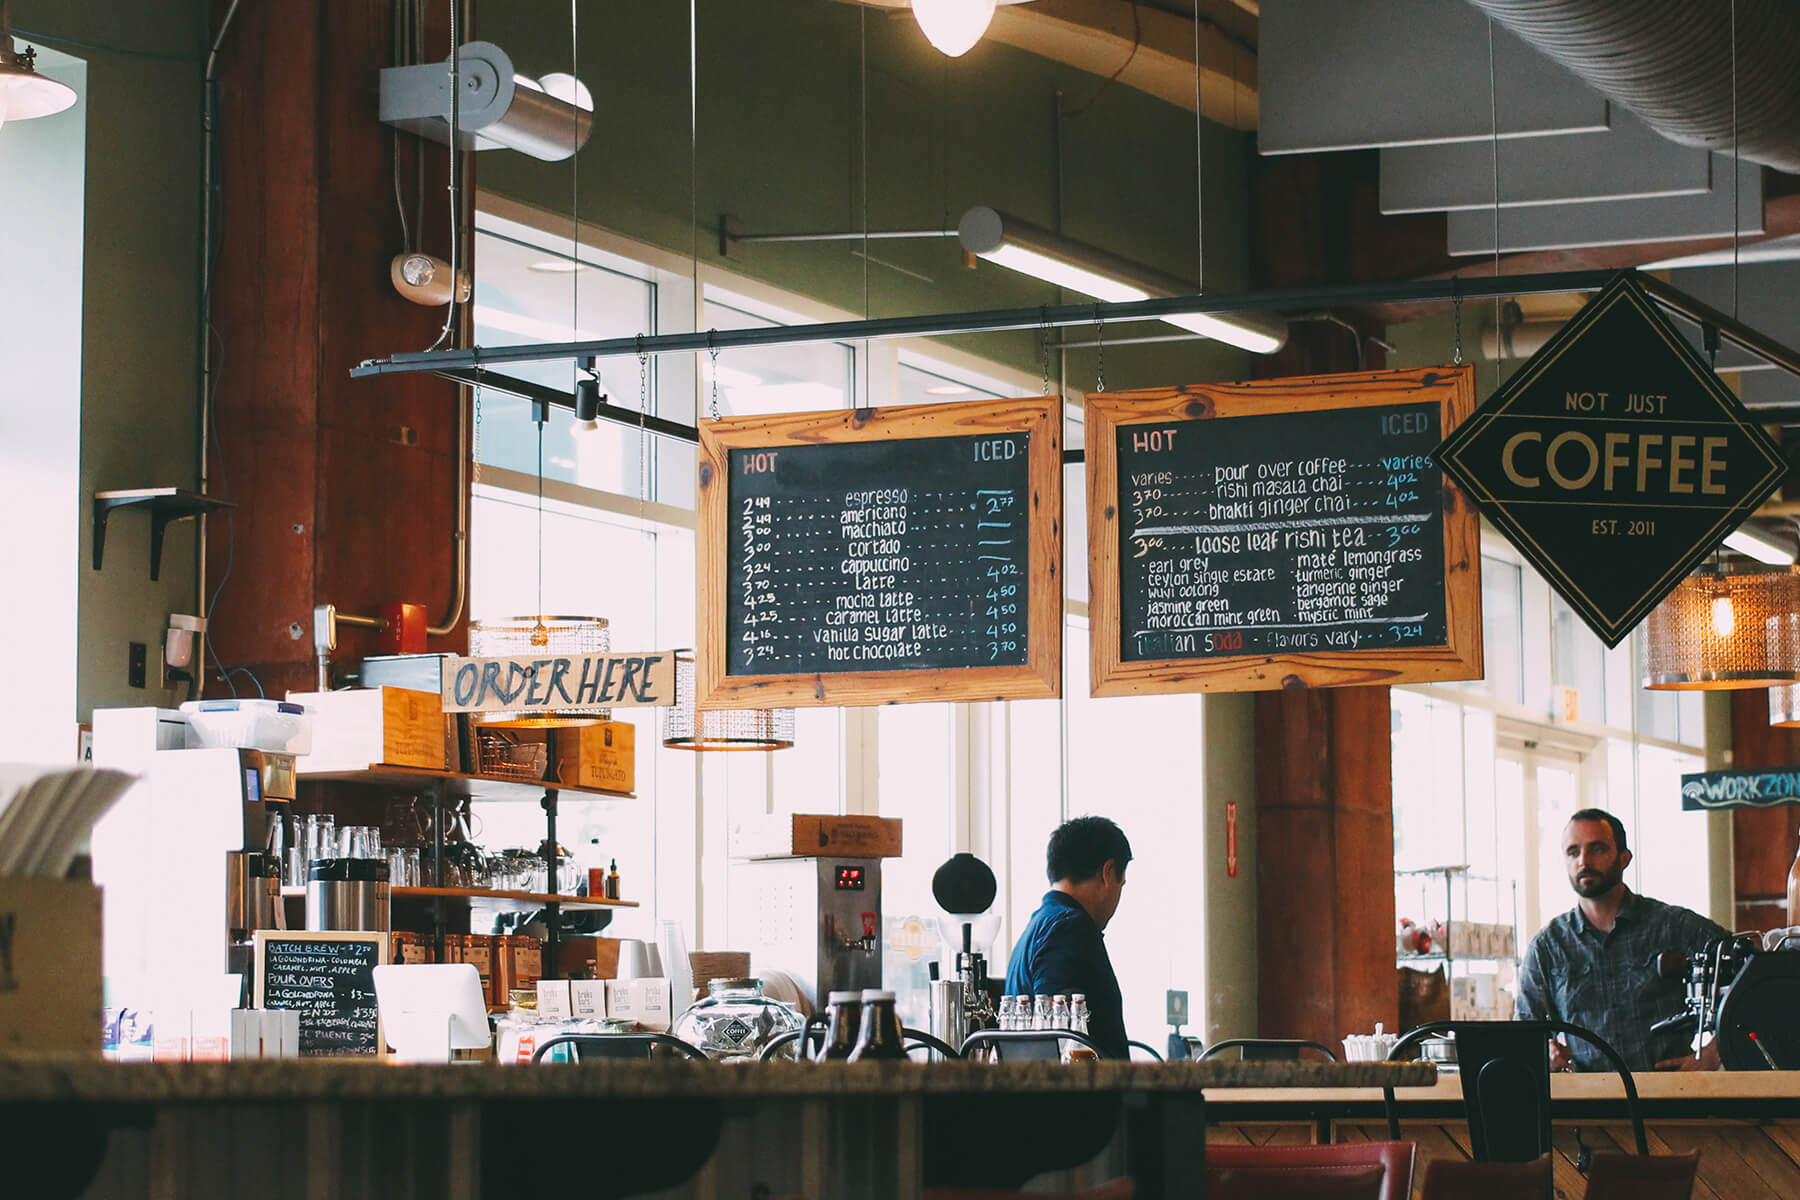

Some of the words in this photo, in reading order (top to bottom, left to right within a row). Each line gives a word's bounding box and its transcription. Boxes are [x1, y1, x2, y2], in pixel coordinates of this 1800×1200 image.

[1566, 392, 1609, 411] NOT
[1624, 394, 1668, 414] JUST
[1133, 429, 1177, 453] HOT
[1381, 412, 1428, 435] ICED
[743, 452, 778, 475] HOT
[974, 440, 1016, 462] ICED
[1501, 430, 1728, 494] COFFEE
[1131, 472, 1173, 487] varies
[1215, 464, 1249, 485] pour
[1257, 461, 1293, 479] over
[1298, 457, 1347, 476] coffee
[1382, 454, 1433, 472] varies
[1217, 482, 1248, 499] rishi
[1252, 479, 1307, 497] masala
[1312, 474, 1343, 493] chai
[846, 489, 908, 511] espresso
[1209, 501, 1253, 520] bhakti
[1258, 496, 1312, 519] ginger
[1314, 494, 1350, 513] chai
[840, 505, 907, 524] americano
[842, 521, 906, 540] macchiato
[1592, 520, 1622, 536] EST.
[1628, 520, 1655, 537] 2011
[848, 539, 901, 557] cortado
[1195, 535, 1240, 554] loose
[1248, 530, 1280, 552] leaf
[1285, 528, 1326, 549] rishi
[1332, 526, 1367, 548] tea
[841, 556, 910, 577] cappuccino
[1149, 559, 1174, 574] earl
[1179, 557, 1209, 574] grey
[1344, 548, 1422, 567] lemongrass
[855, 575, 896, 590] latte
[1148, 573, 1189, 588] ceylon
[1194, 570, 1229, 585] single
[1234, 568, 1276, 583] estate
[1295, 568, 1343, 583] turmeric
[1349, 565, 1392, 581] ginger
[1148, 586, 1175, 600] wuyi
[1179, 584, 1220, 598] oolong
[1297, 581, 1357, 598] tangerine
[1360, 579, 1404, 595] ginger
[836, 592, 875, 609] mocha
[880, 591, 914, 608] latte
[1147, 600, 1192, 617] jasmine
[1196, 599, 1229, 615] green
[1297, 594, 1357, 611] bergamot
[1361, 594, 1388, 607] sage
[825, 609, 880, 625] caramel
[885, 608, 922, 624] latte
[1147, 612, 1209, 629] moroccan
[1214, 611, 1243, 626] mint
[1247, 608, 1281, 624] green
[1298, 608, 1339, 625] mystic
[1344, 607, 1374, 620] mint
[813, 627, 859, 643] vanilla
[864, 625, 907, 642] sugar
[912, 623, 947, 640] latte
[1205, 632, 1242, 652] soda
[1267, 631, 1319, 648] flavors
[1325, 630, 1359, 648] vary
[828, 644, 850, 661] hot
[853, 641, 922, 661] chocolate
[454, 658, 573, 706] ORDER
[576, 656, 663, 703] HERE
[1701, 776, 1762, 800] WORK
[268, 943, 302, 953] BATCH
[305, 944, 340, 954] BREW
[268, 972, 297, 985] POUR
[299, 976, 334, 989] OVERS
